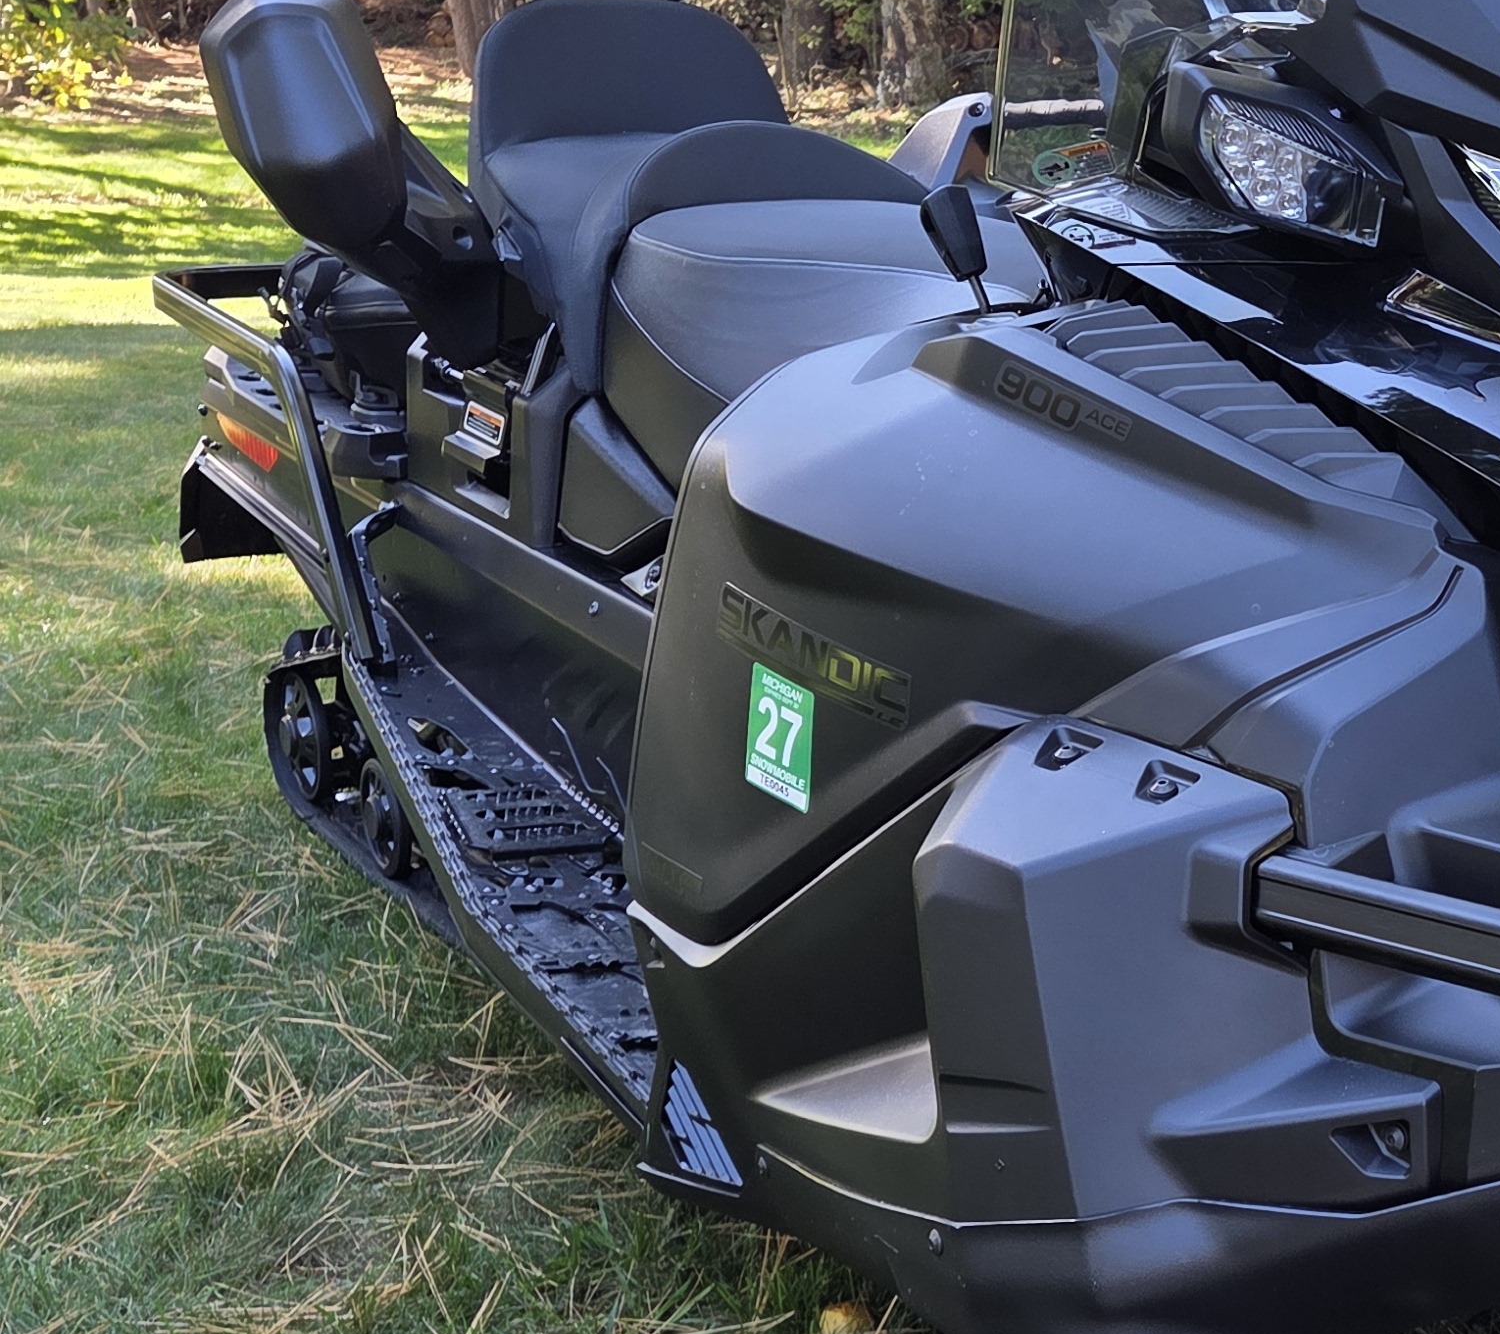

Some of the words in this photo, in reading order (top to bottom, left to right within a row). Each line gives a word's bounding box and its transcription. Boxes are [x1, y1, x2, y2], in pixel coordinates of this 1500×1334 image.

[997, 366, 1082, 428] 900
[1086, 408, 1131, 438] ACE
[721, 584, 908, 714] SKANDIC
[761, 672, 804, 704] MICHIGAN
[754, 696, 803, 768] 27
[749, 752, 806, 791] SNOWMOBILE
[759, 772, 790, 797] TE0045
